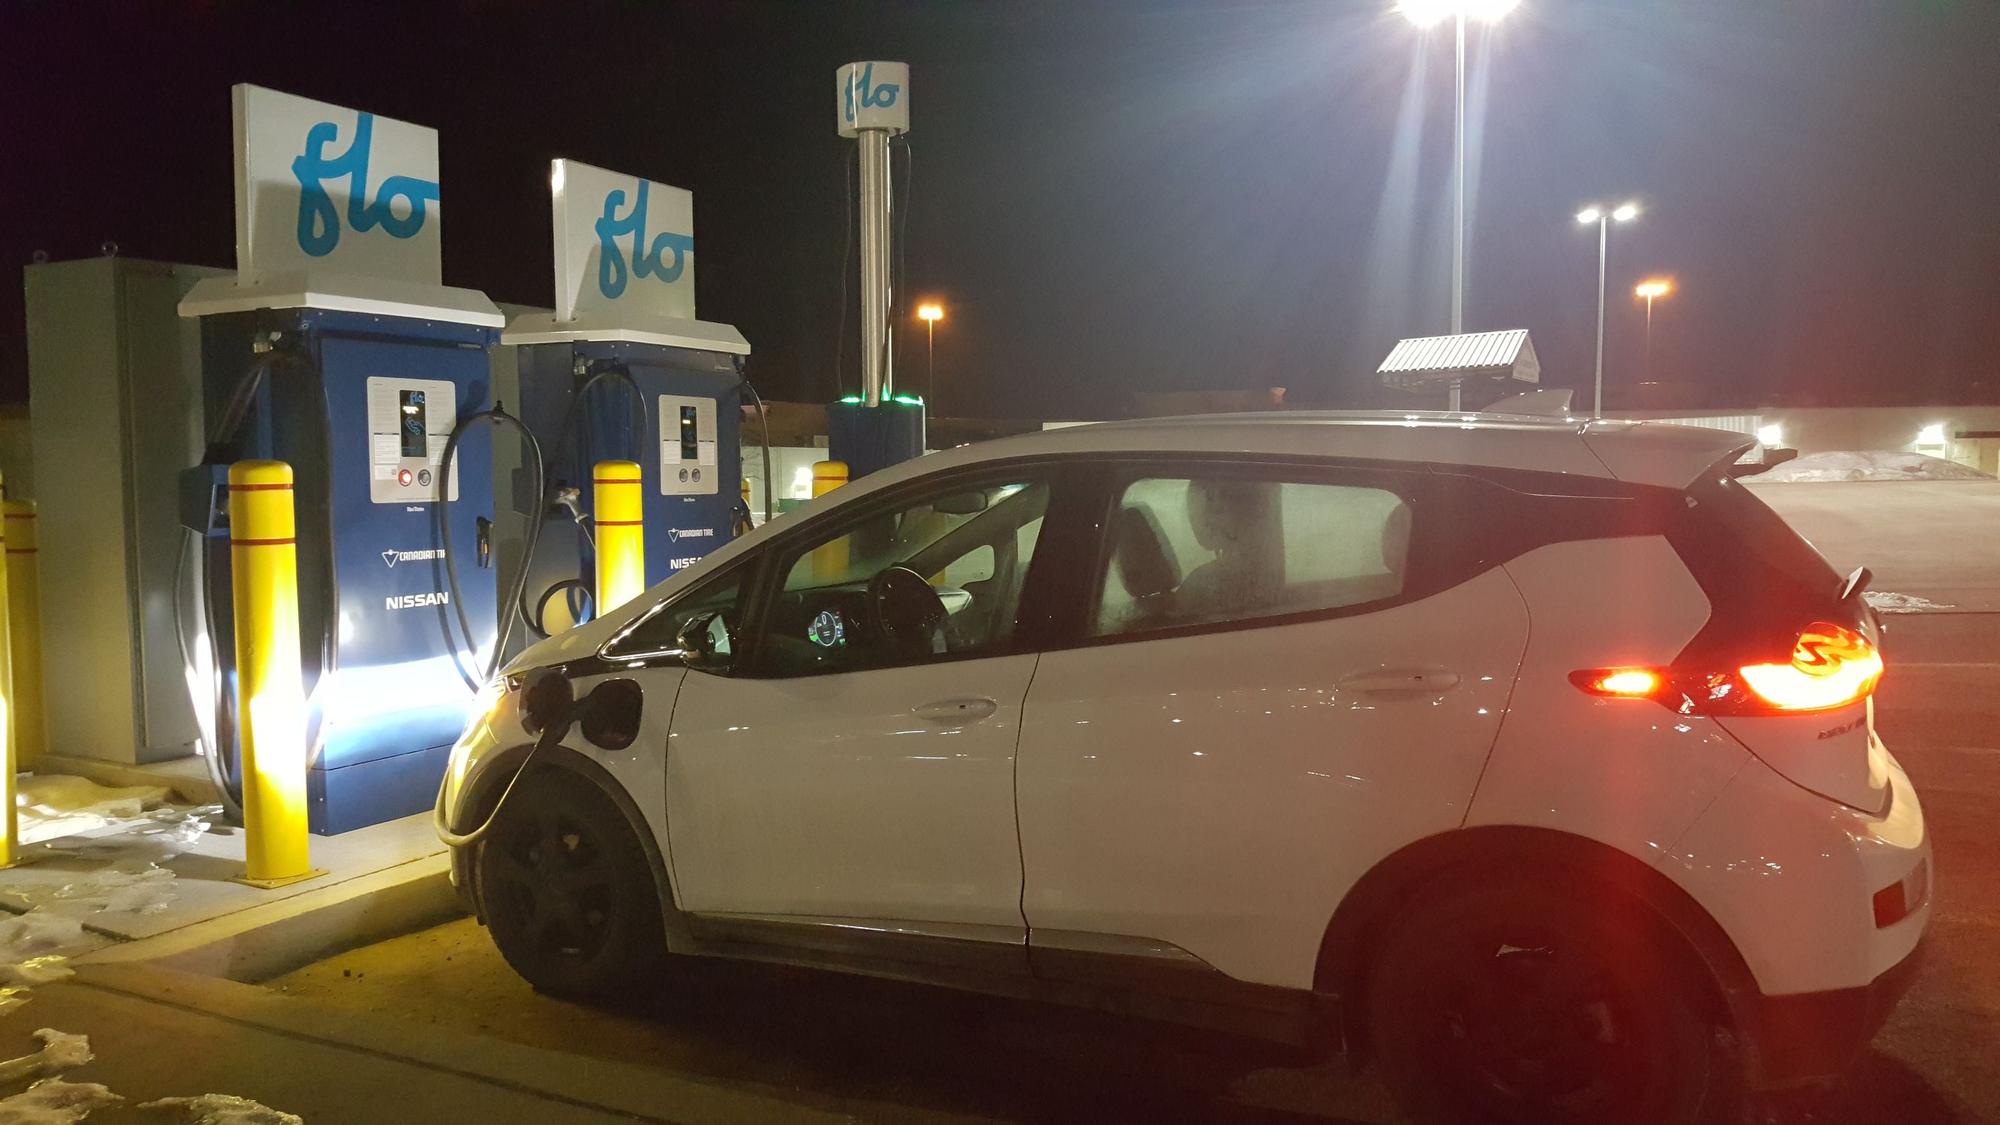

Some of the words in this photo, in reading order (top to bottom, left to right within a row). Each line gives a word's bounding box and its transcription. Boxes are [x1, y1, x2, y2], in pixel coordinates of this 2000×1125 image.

[845, 62, 899, 122] flo
[291, 111, 440, 257] flo
[595, 178, 694, 299] flo
[399, 550, 436, 561] CANADIAN
[670, 556, 702, 570] NISS
[385, 591, 449, 610] NISSAN
